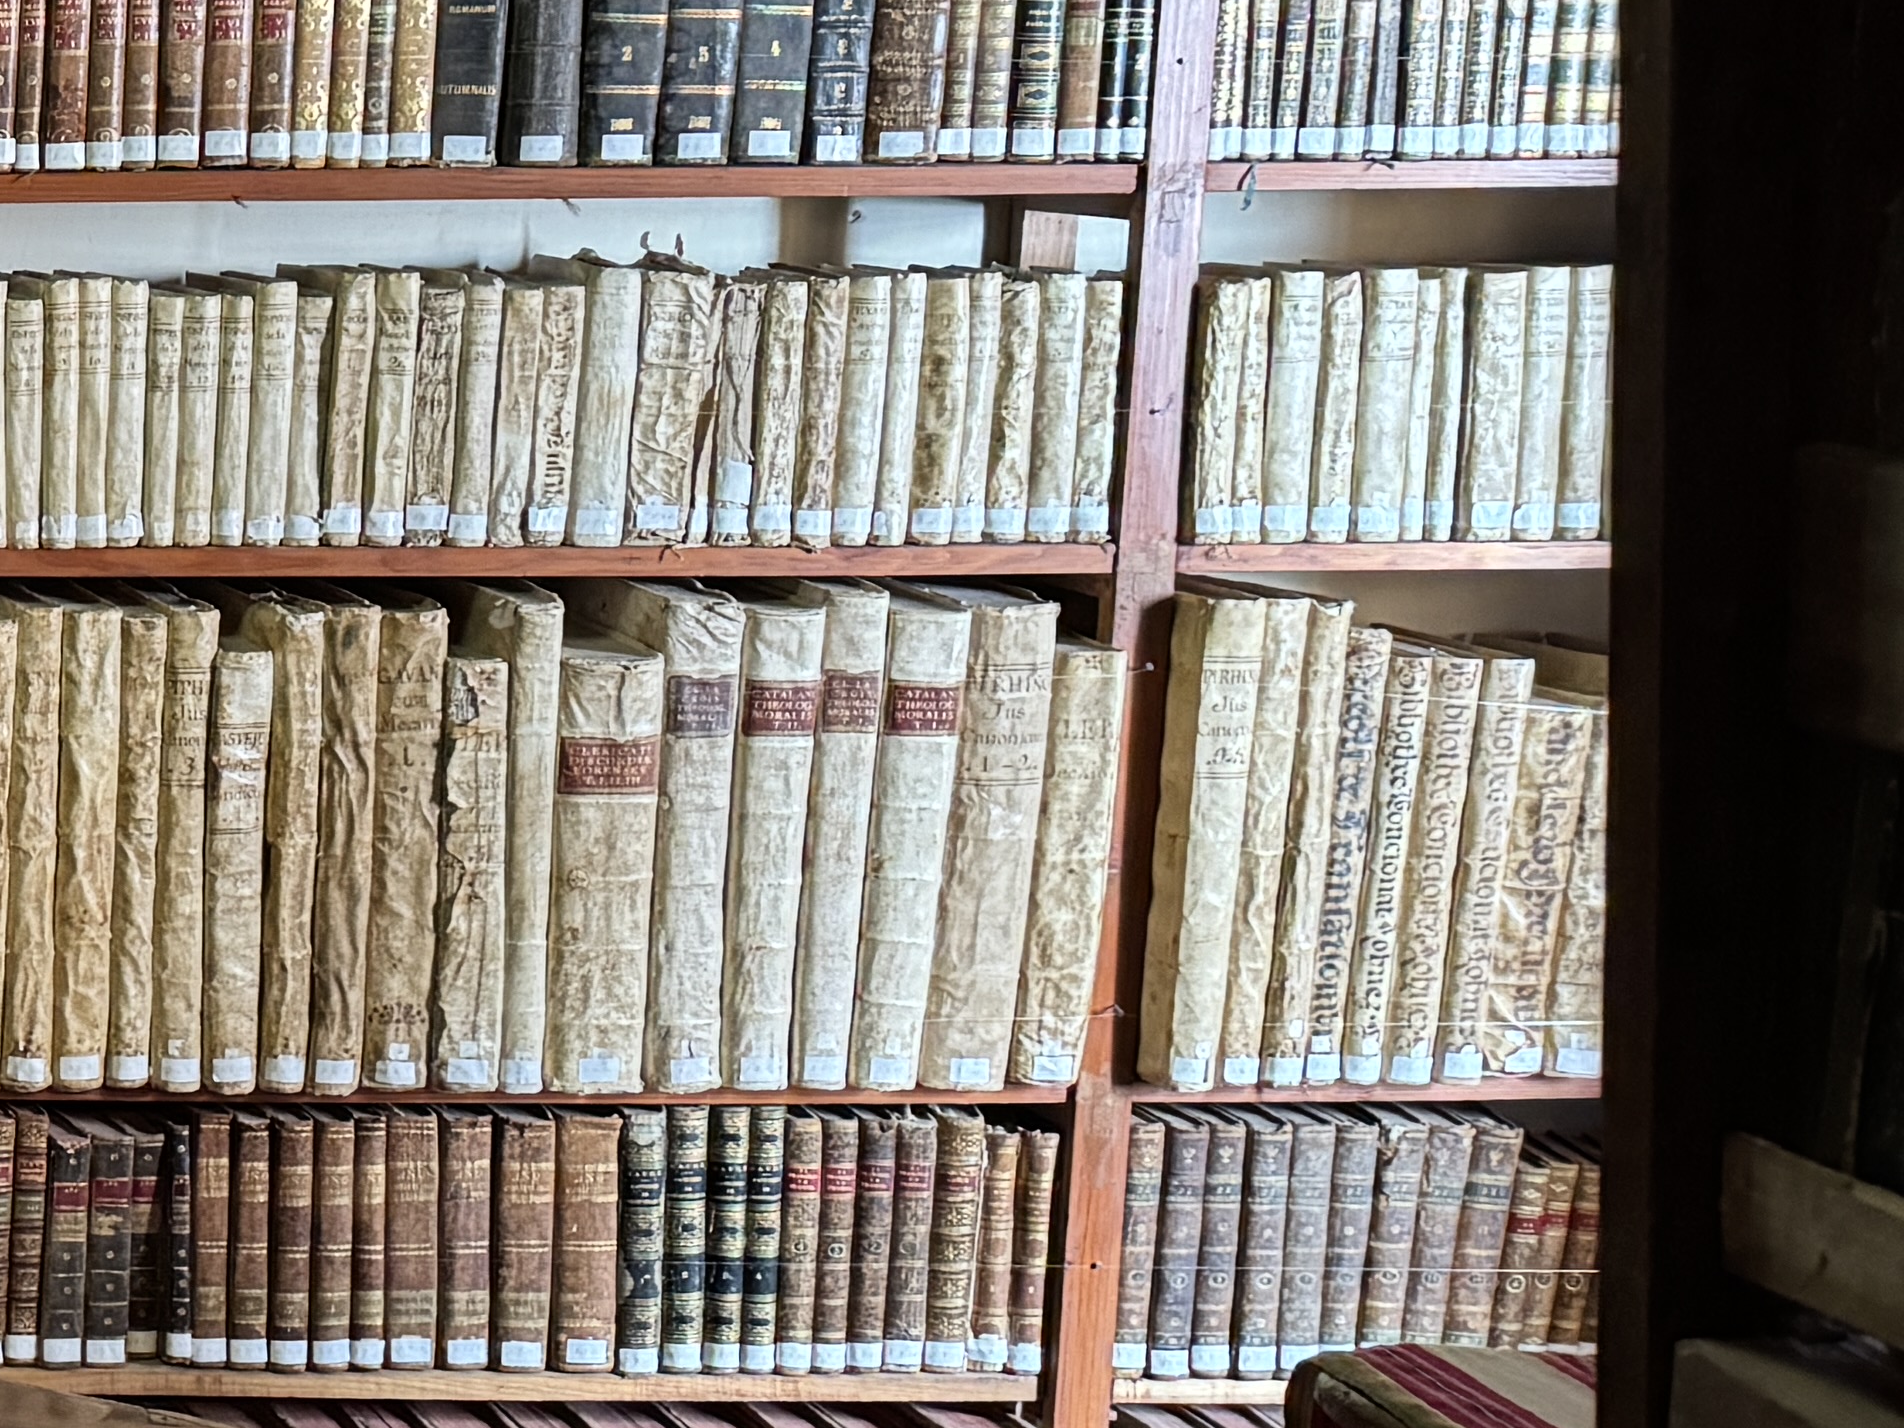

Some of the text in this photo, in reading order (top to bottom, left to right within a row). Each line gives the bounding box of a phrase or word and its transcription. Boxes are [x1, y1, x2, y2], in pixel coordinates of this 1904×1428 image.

[622, 46, 633, 62] 2
[754, 700, 814, 710] THEOLOG
[894, 700, 955, 710] THEOLOG
[983, 700, 1026, 721] Jus
[752, 711, 813, 721] MORALIS
[894, 711, 955, 721] MORALIS
